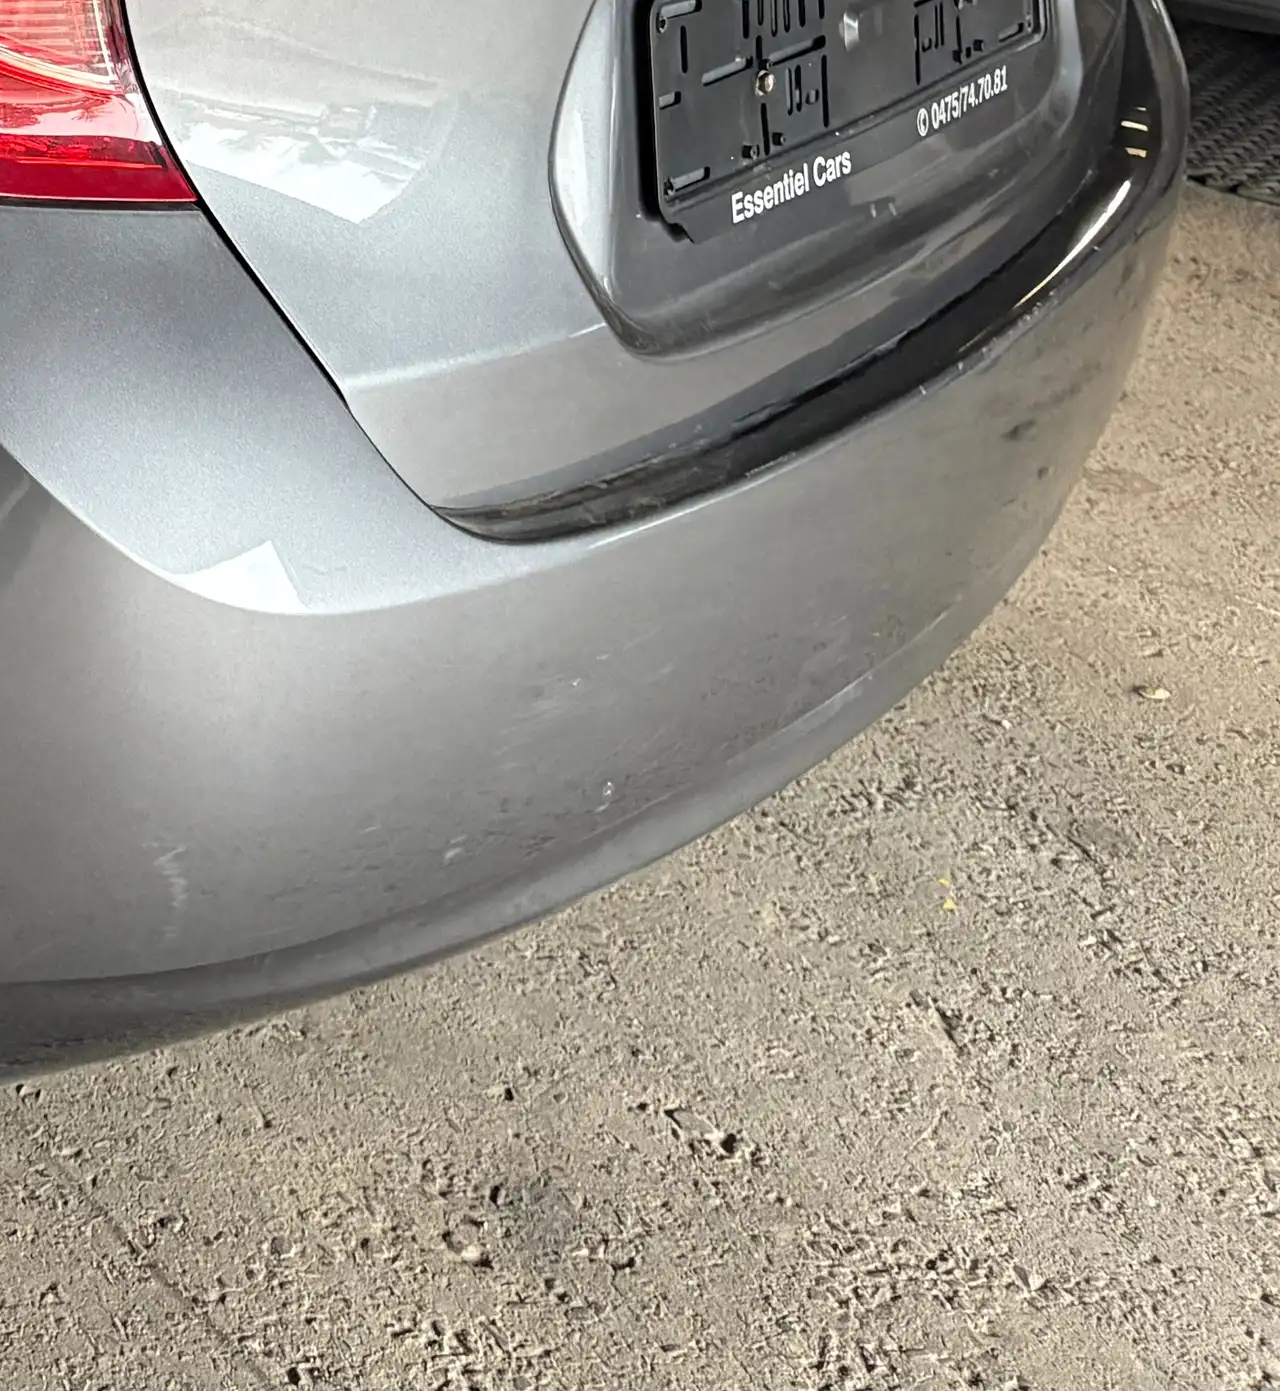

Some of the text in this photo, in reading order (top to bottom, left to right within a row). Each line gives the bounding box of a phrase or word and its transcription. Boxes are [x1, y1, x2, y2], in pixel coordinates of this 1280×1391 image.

[931, 65, 1008, 129] 0475/74.70.81
[731, 151, 852, 224] Essentiel Cars
